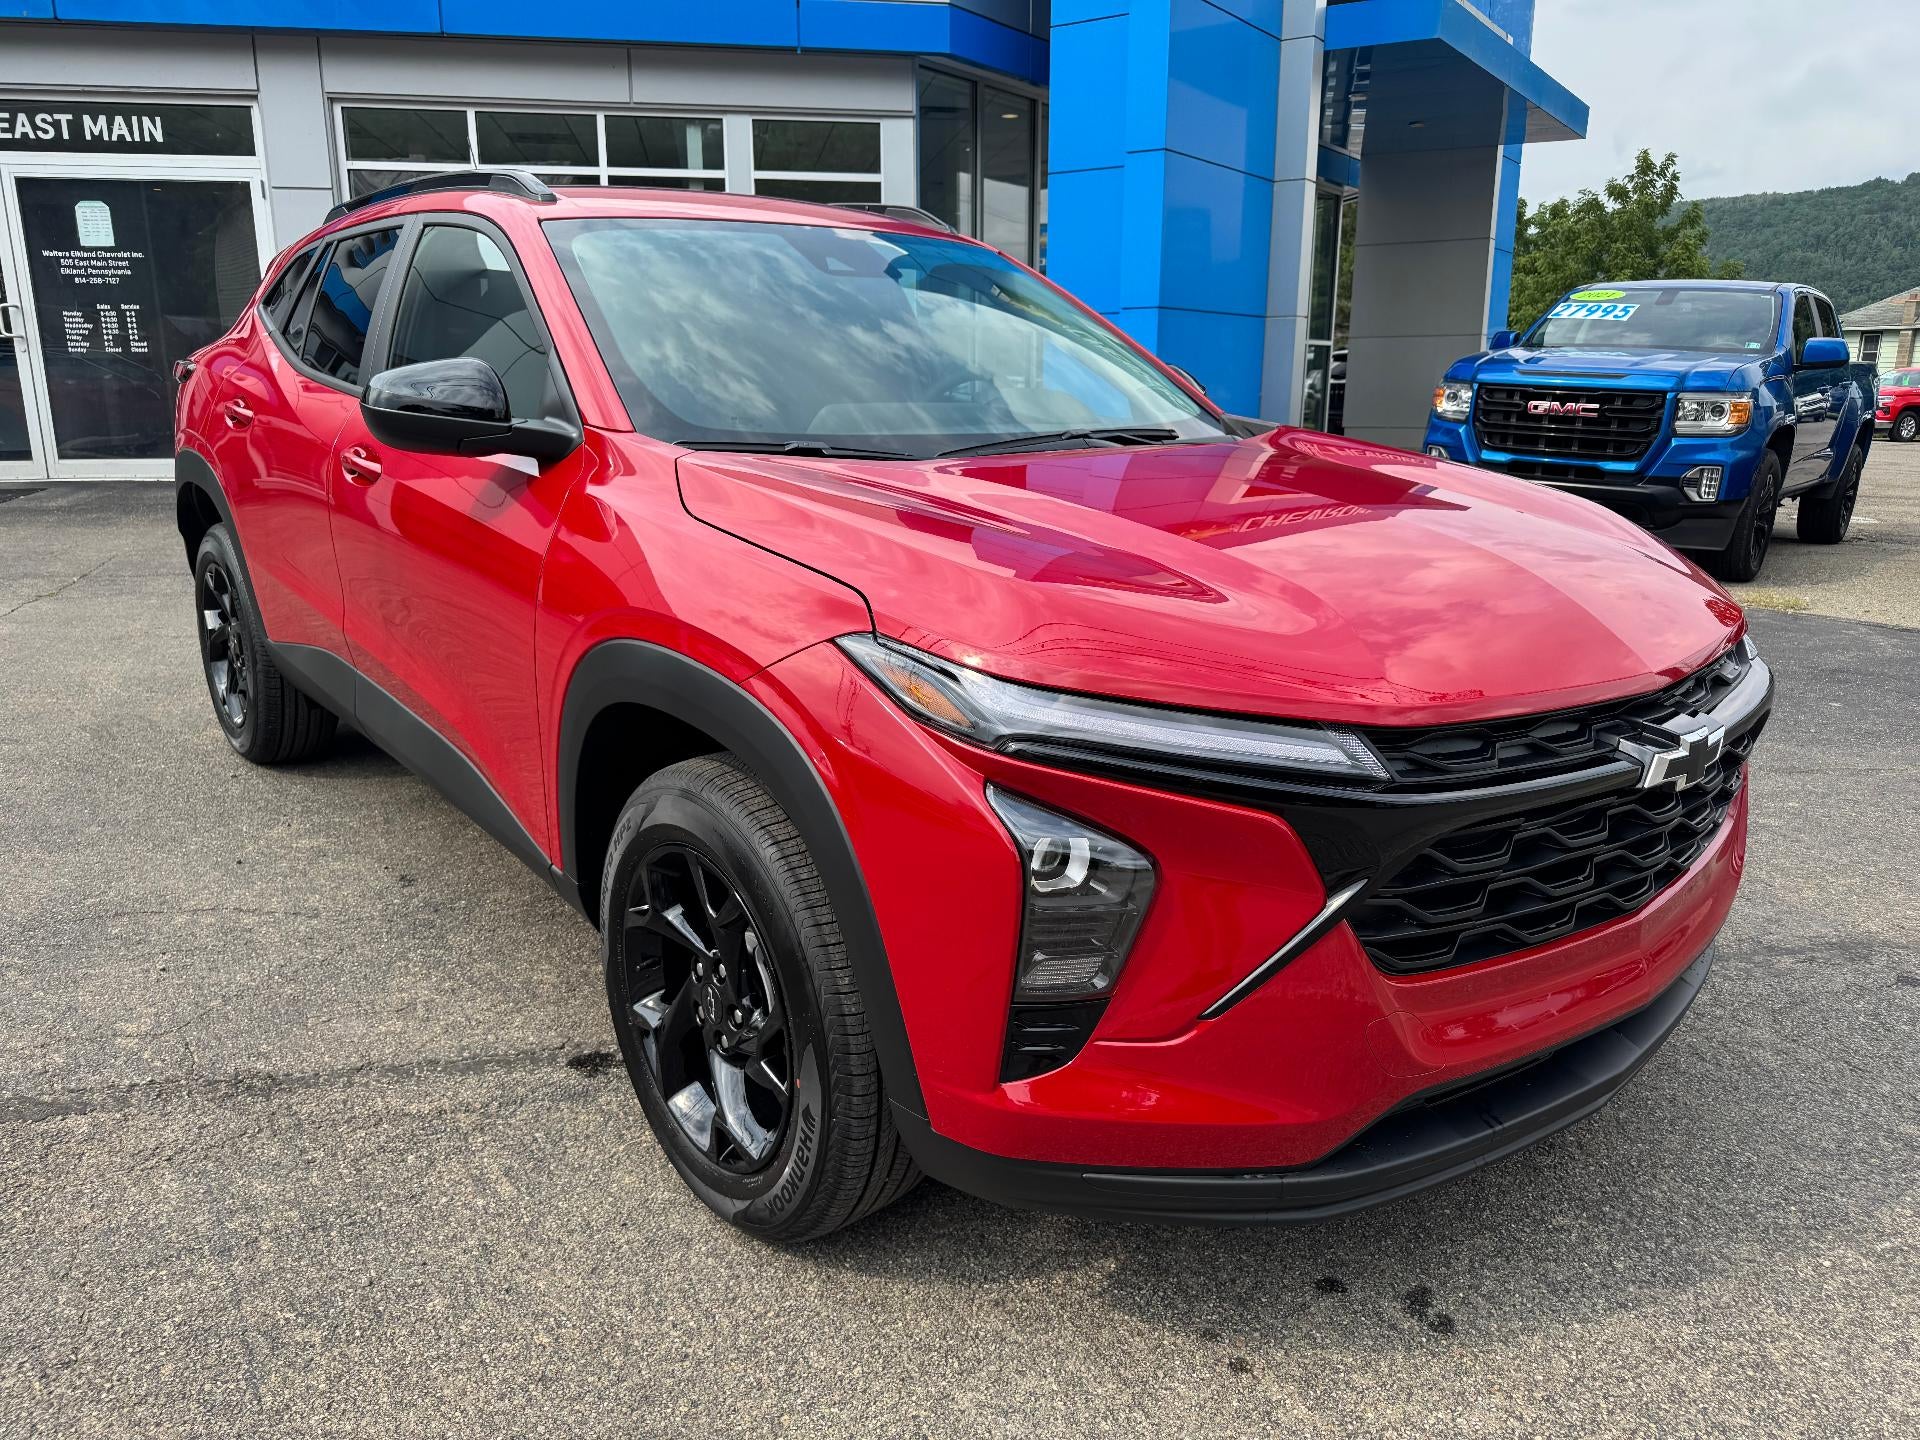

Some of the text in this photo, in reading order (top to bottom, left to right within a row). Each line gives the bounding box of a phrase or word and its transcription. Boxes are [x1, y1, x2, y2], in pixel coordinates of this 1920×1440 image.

[0, 112, 164, 143] EAST MAIN
[88, 268, 131, 276] Pennsylvania
[1550, 304, 1636, 319] 27995
[1528, 400, 1600, 418] GMC
